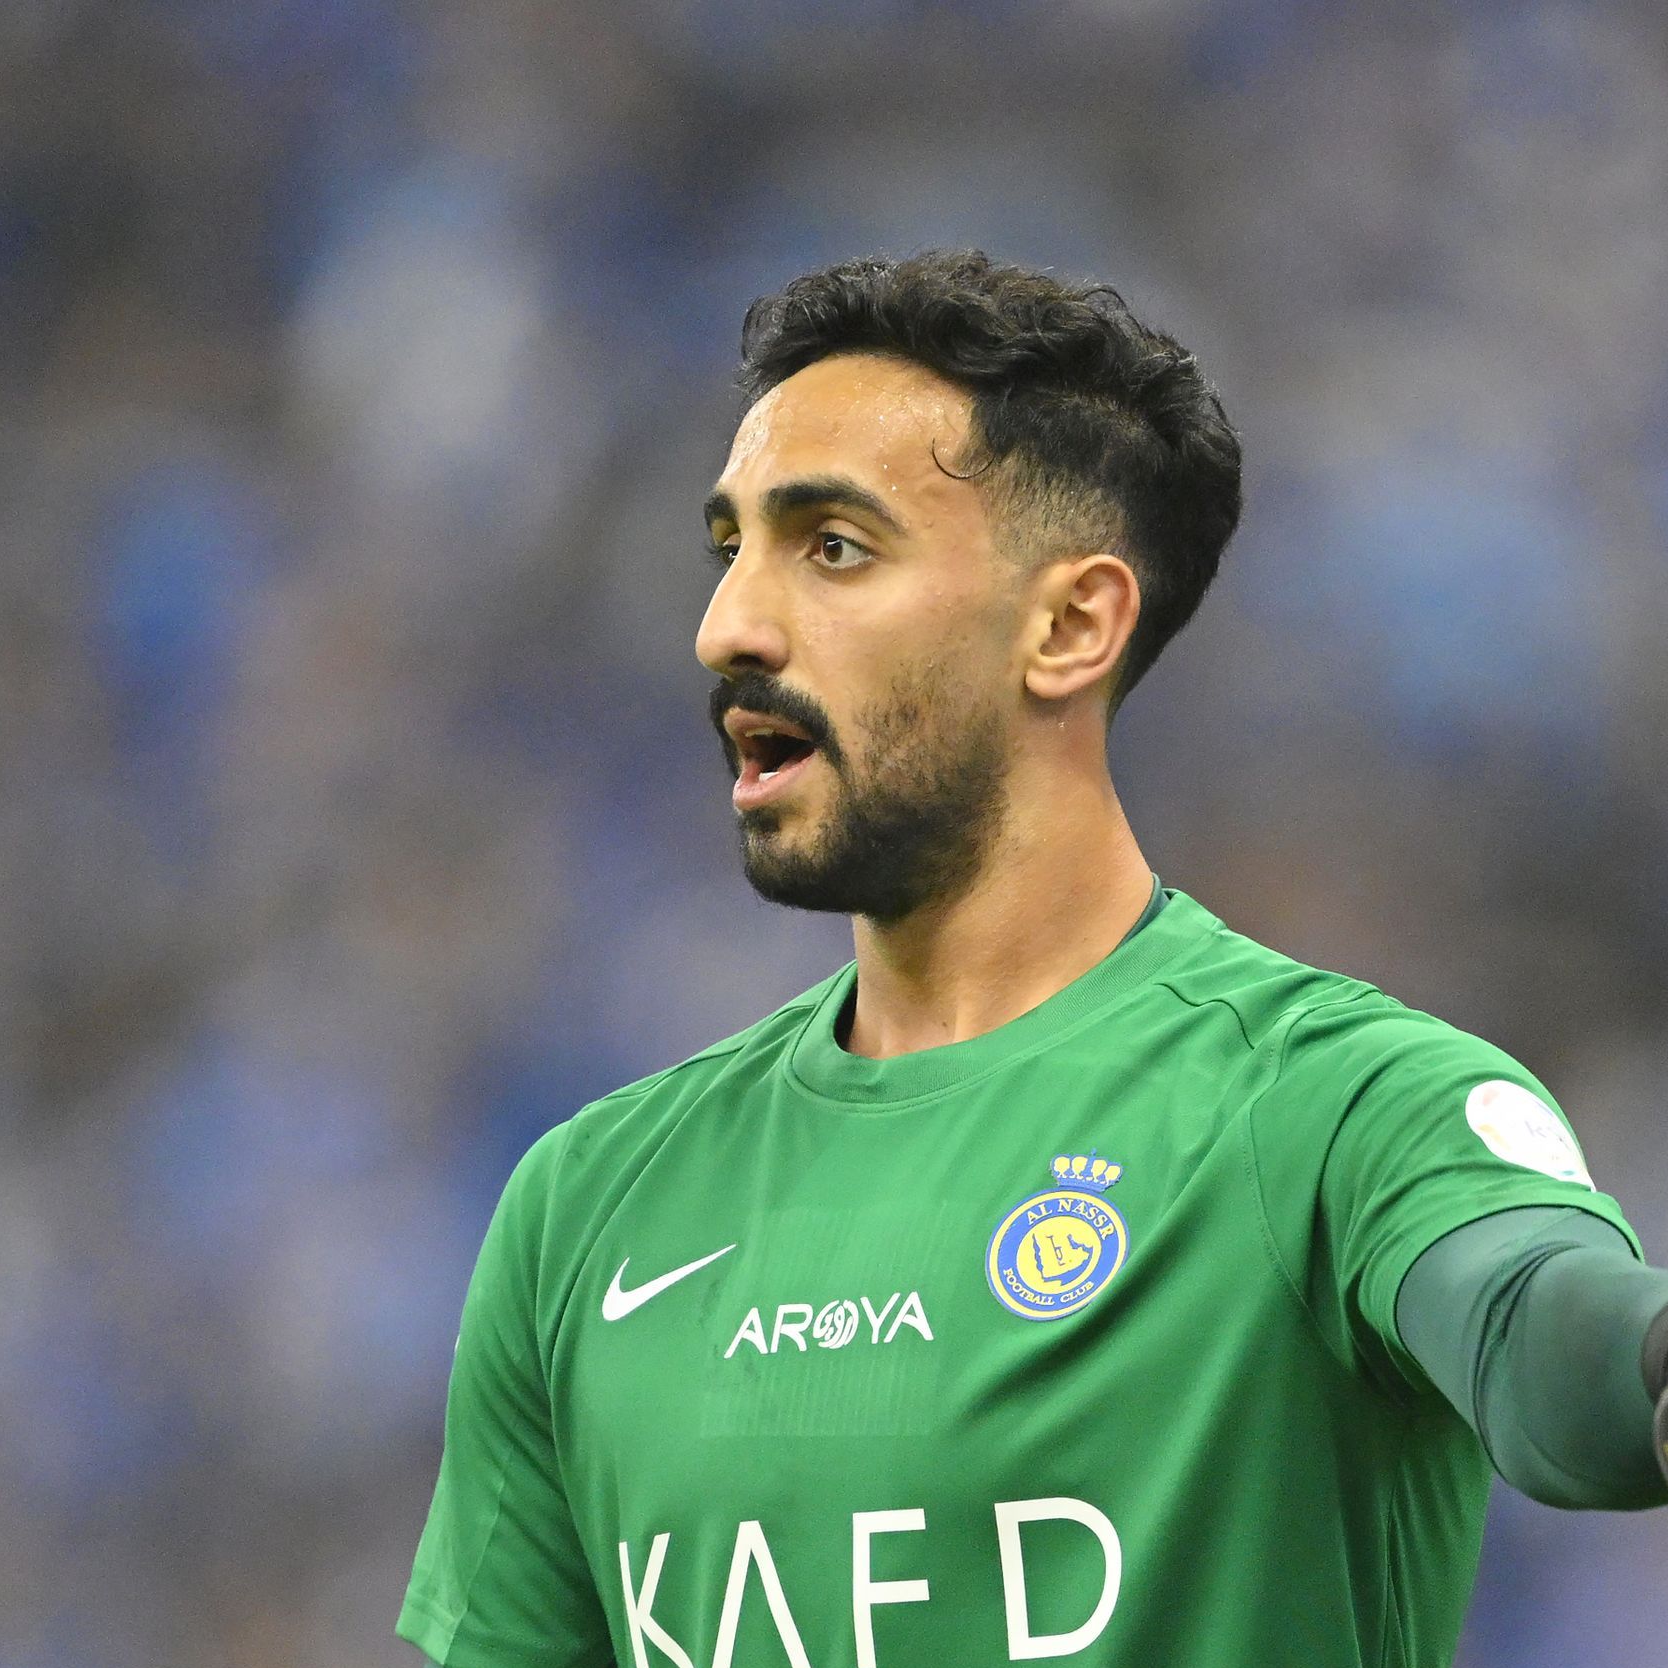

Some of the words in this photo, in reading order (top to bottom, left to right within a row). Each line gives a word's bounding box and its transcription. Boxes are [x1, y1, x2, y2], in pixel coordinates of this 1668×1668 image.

[1026, 1202, 1053, 1226] AL
[1058, 1199, 1115, 1240] NASSR
[1003, 1267, 1055, 1306] FOOTBALL
[1059, 1281, 1095, 1304] CLUB
[723, 1291, 934, 1359] AROYA
